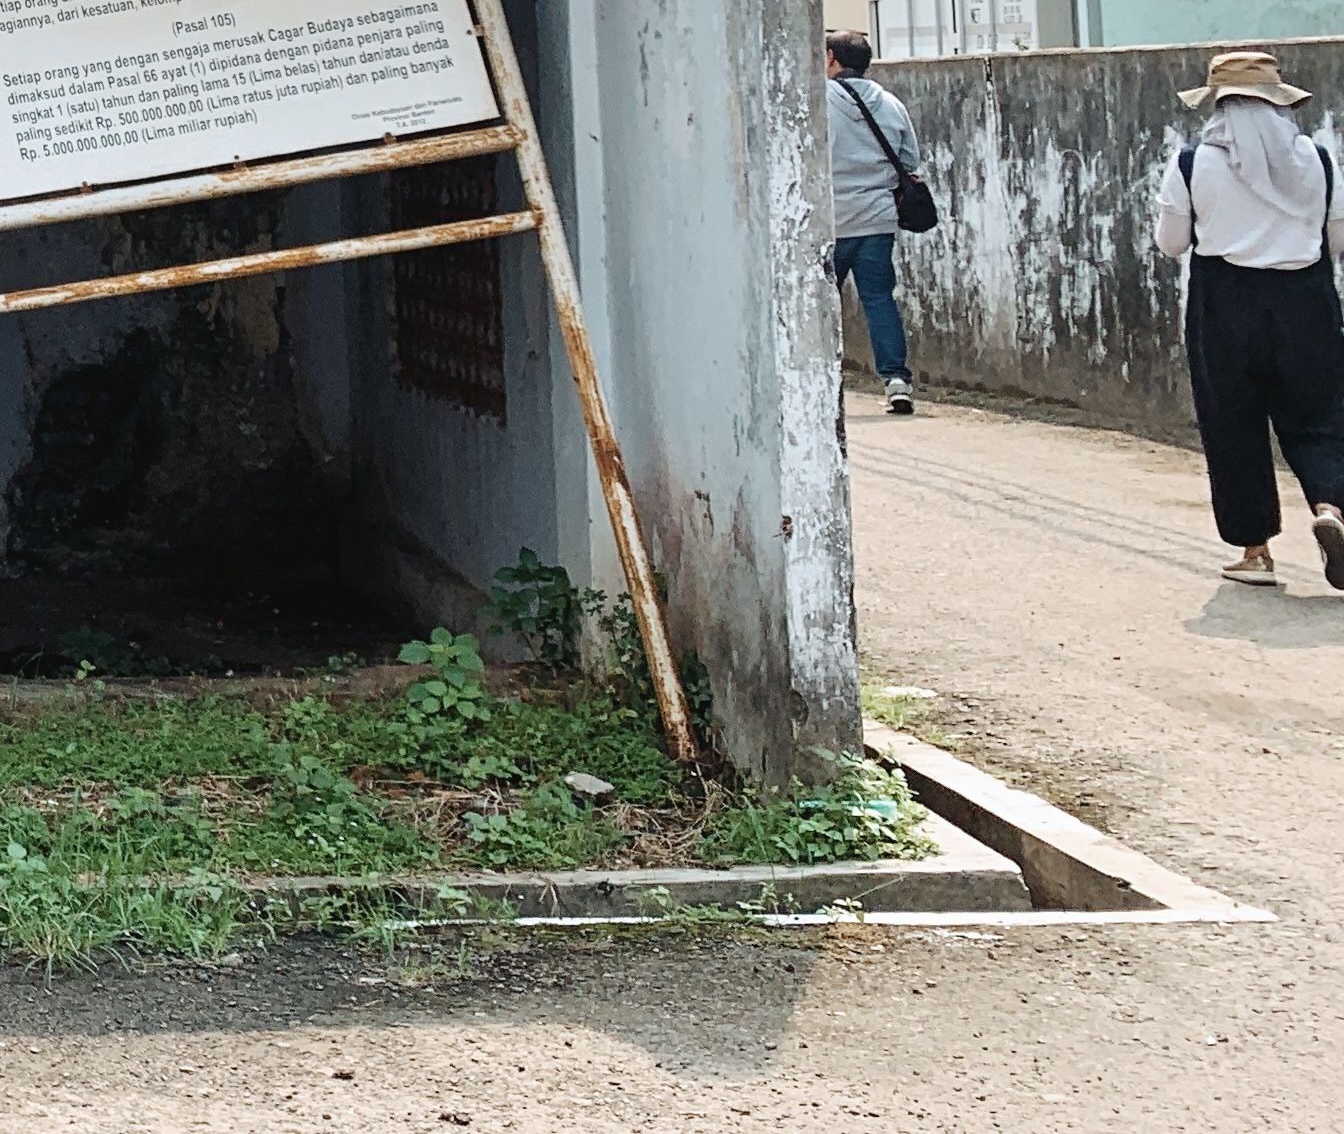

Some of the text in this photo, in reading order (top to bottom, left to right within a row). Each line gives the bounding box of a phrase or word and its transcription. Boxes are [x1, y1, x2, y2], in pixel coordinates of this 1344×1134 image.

[56, 6, 80, 23] dari
[80, 0, 138, 18] kesatuan,
[171, 12, 236, 38] (Pasal 105)
[1, 71, 42, 88] Setiap
[43, 65, 80, 81] orang
[80, 60, 113, 78] yang
[113, 51, 160, 69] dengan
[161, 41, 211, 61] sengaja
[211, 30, 266, 52] merusak
[267, 25, 304, 43] Cagar
[305, 17, 355, 35] Budaya
[355, 1, 439, 26] sebagaimana
[6, 19, 445, 106] dimaksud dalam Pasal 66 ayat (1) dipidana dengan pidana penjara paling
